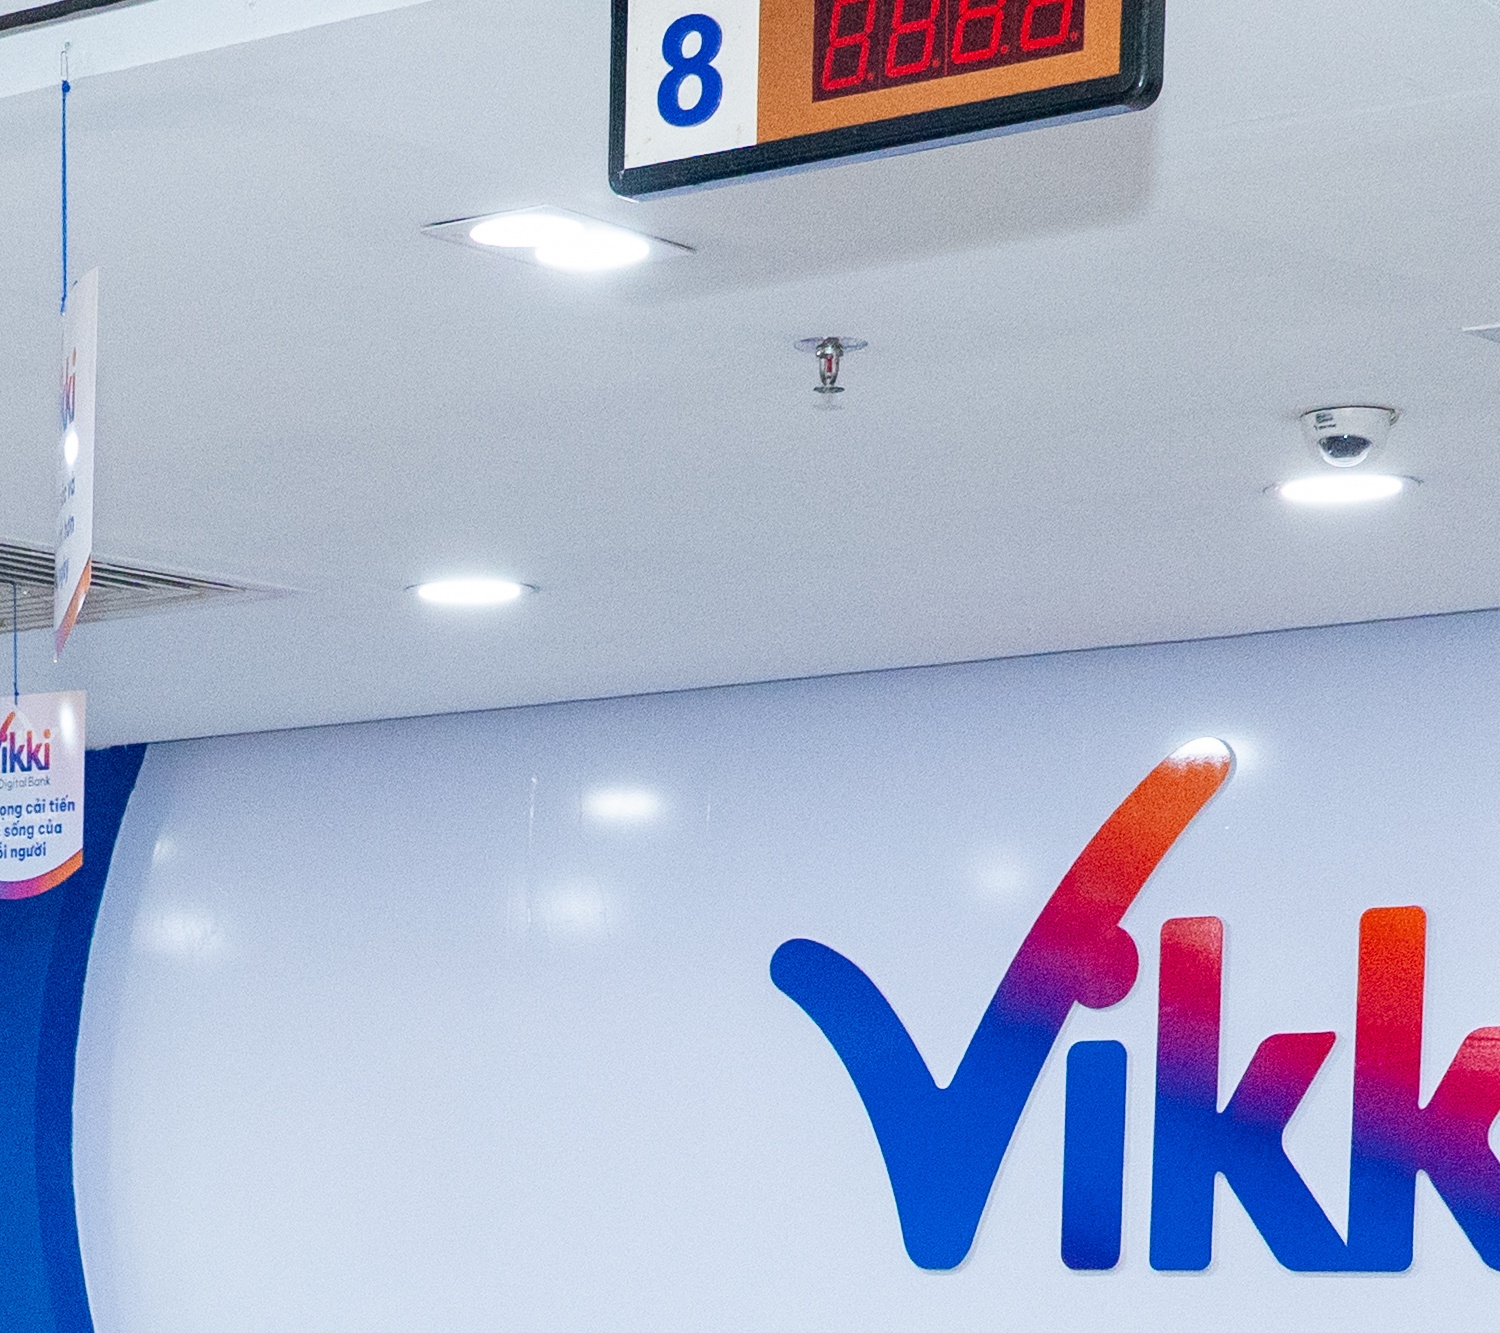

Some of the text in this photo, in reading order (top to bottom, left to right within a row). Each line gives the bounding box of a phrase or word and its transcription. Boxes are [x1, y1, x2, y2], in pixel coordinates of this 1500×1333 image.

[656, 12, 724, 128] 8
[5, 819, 35, 839] sống
[11, 842, 47, 861] người
